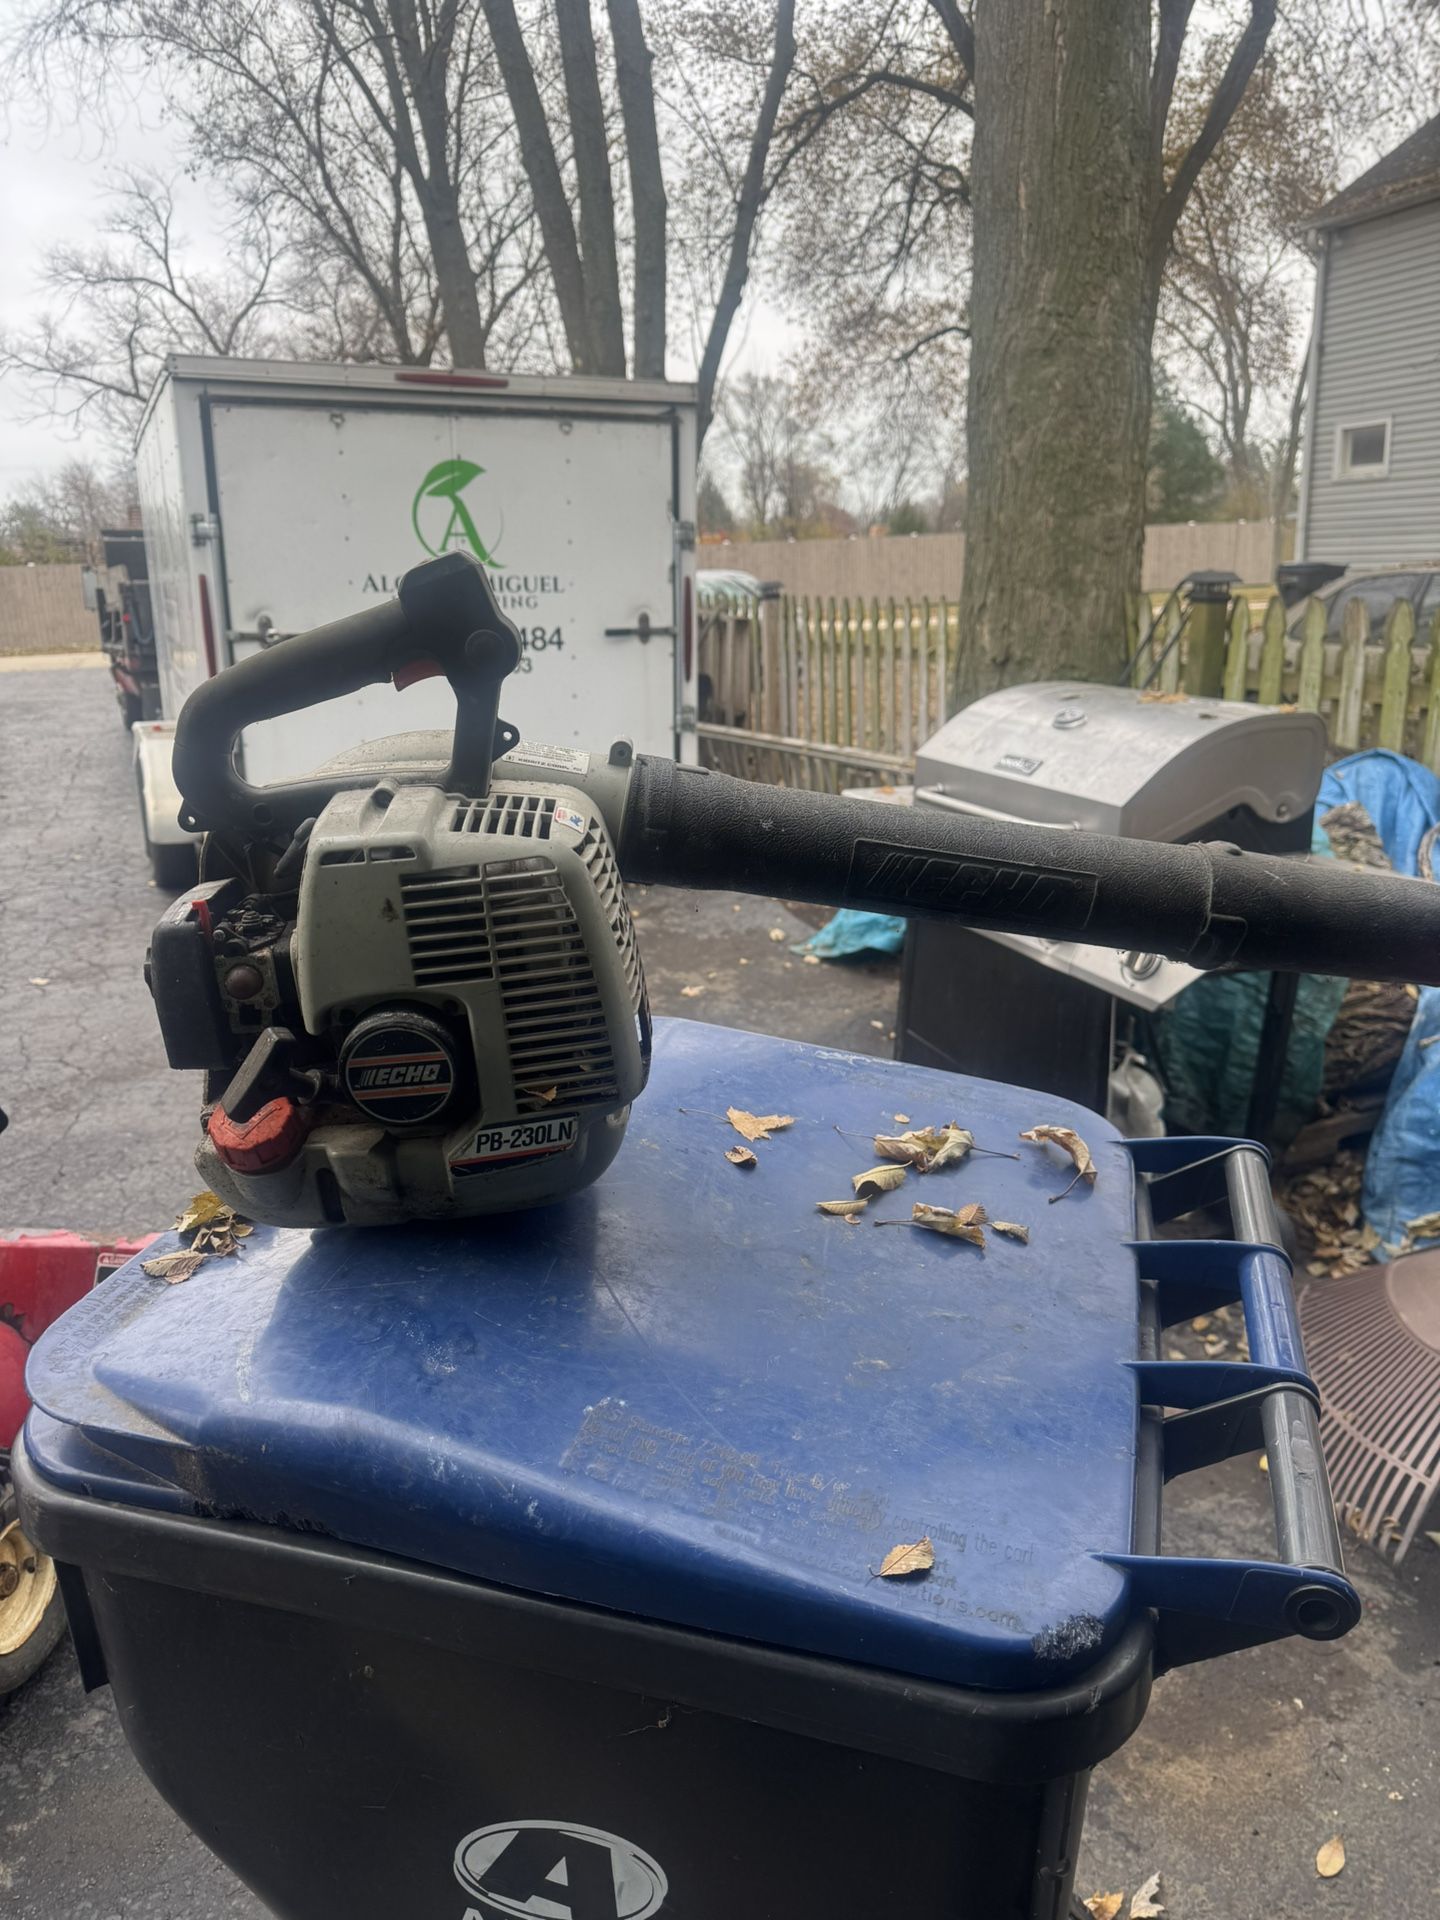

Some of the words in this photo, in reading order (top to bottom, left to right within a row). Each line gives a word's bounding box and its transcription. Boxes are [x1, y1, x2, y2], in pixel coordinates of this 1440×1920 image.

[374, 1064, 441, 1086] ECHO
[476, 1121, 573, 1153] PB-230LN
[892, 1514, 967, 1552] controlling
[975, 1531, 998, 1551] the
[1003, 1543, 1035, 1562] cart
